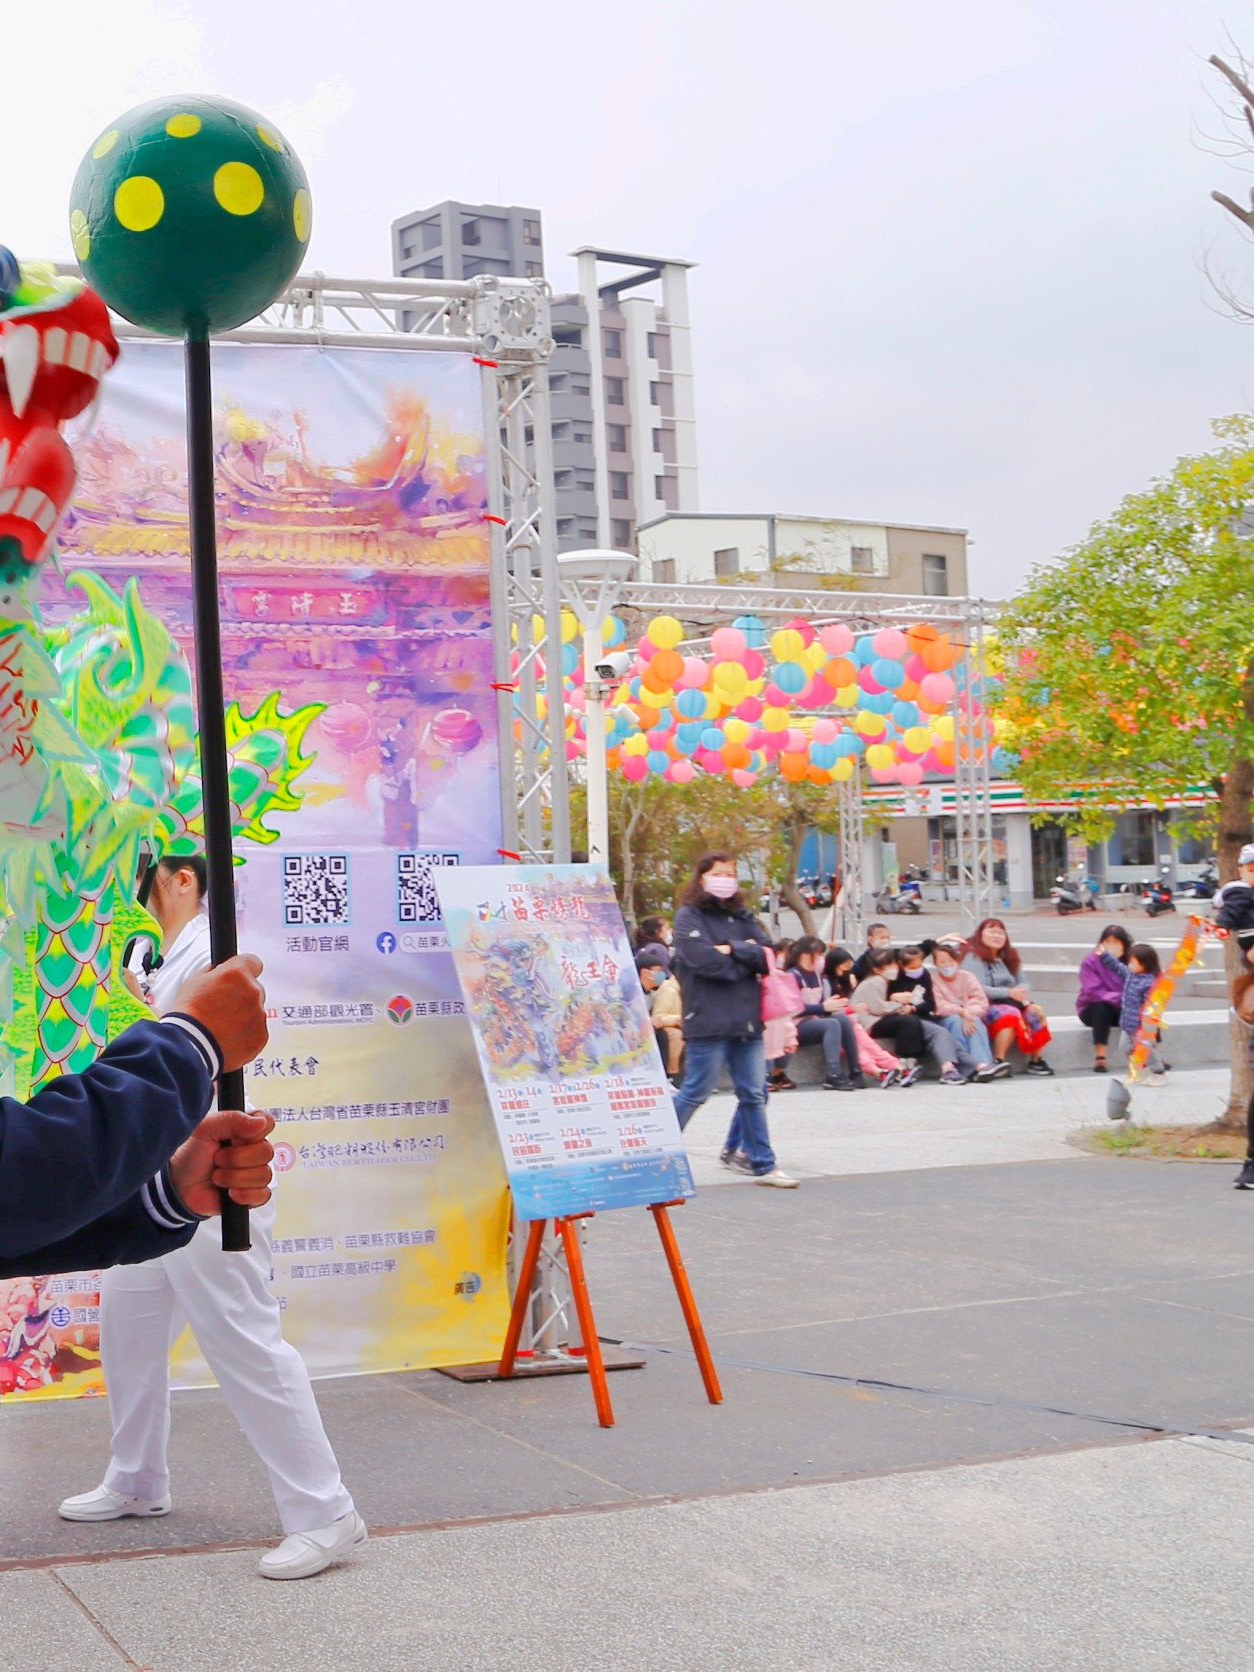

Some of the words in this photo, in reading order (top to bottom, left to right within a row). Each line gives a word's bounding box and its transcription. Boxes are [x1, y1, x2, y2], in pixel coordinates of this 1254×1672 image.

[286, 936, 349, 953] 活動官網
[244, 1056, 320, 1077] 民代表會
[264, 1099, 450, 1123] 團法人台灣省苗栗縣玉清宮財團
